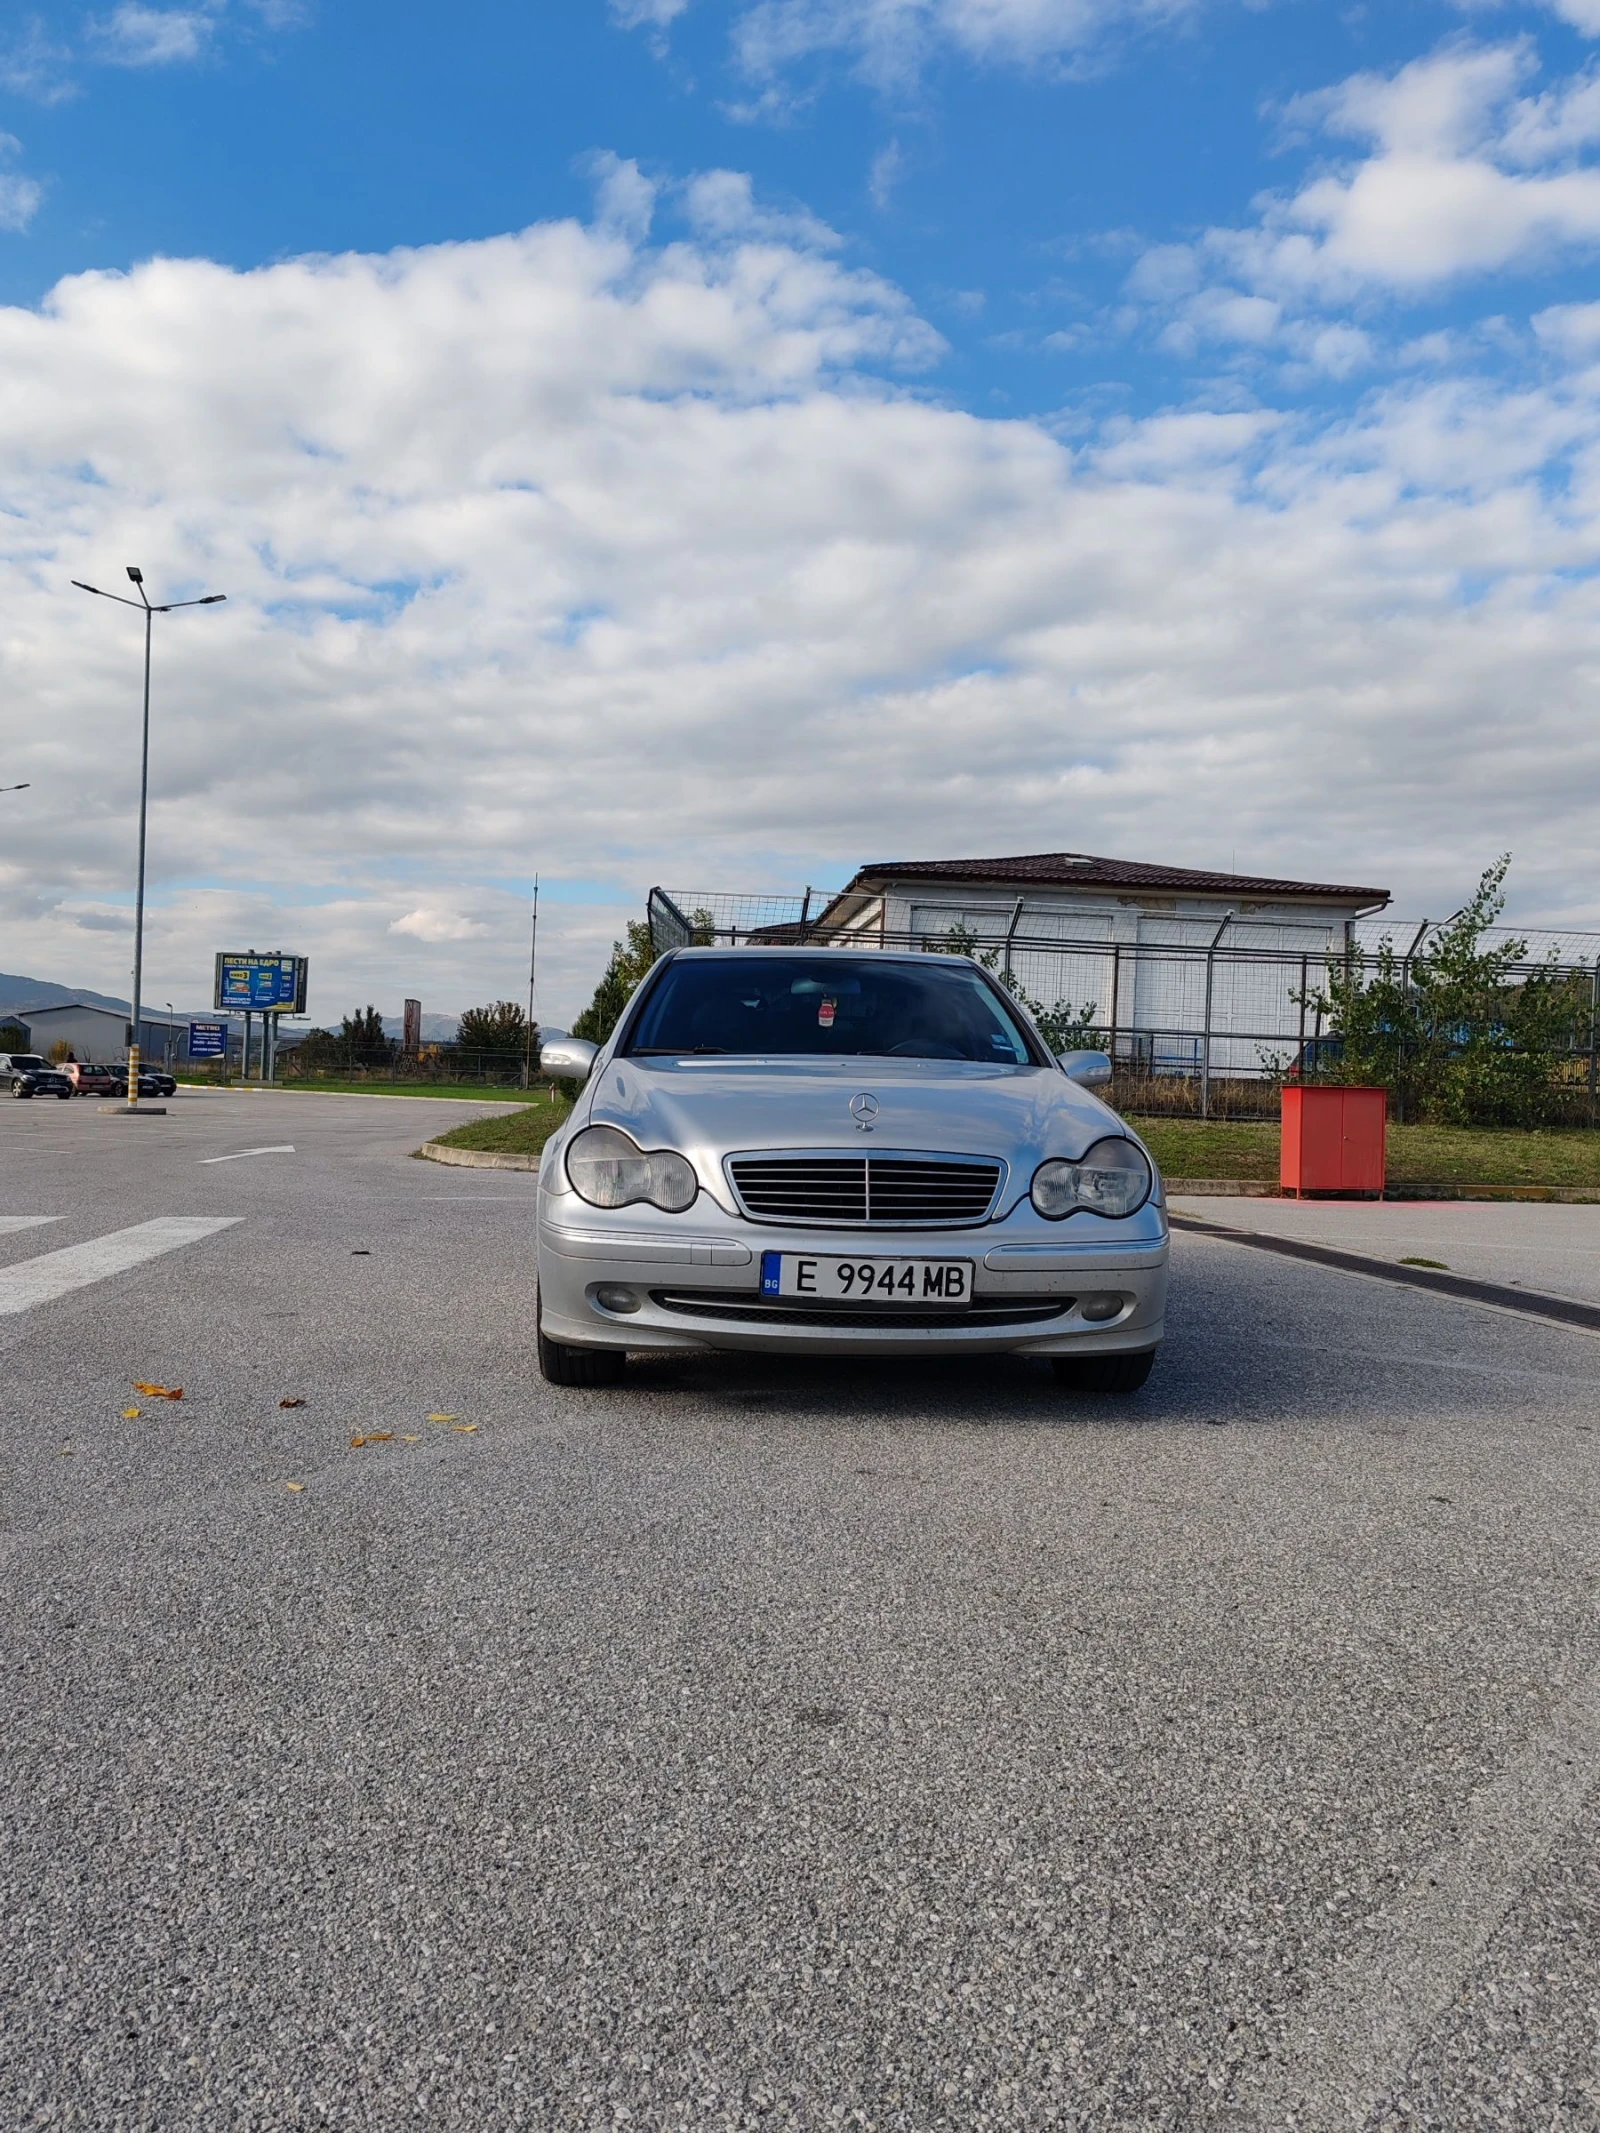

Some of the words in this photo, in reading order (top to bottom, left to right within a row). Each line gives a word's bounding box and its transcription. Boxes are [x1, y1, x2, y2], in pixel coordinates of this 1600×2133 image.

[764, 1279, 778, 1289] BG
[797, 1260, 817, 1292] E
[837, 1263, 915, 1296] 9944
[923, 1266, 965, 1297] MB
